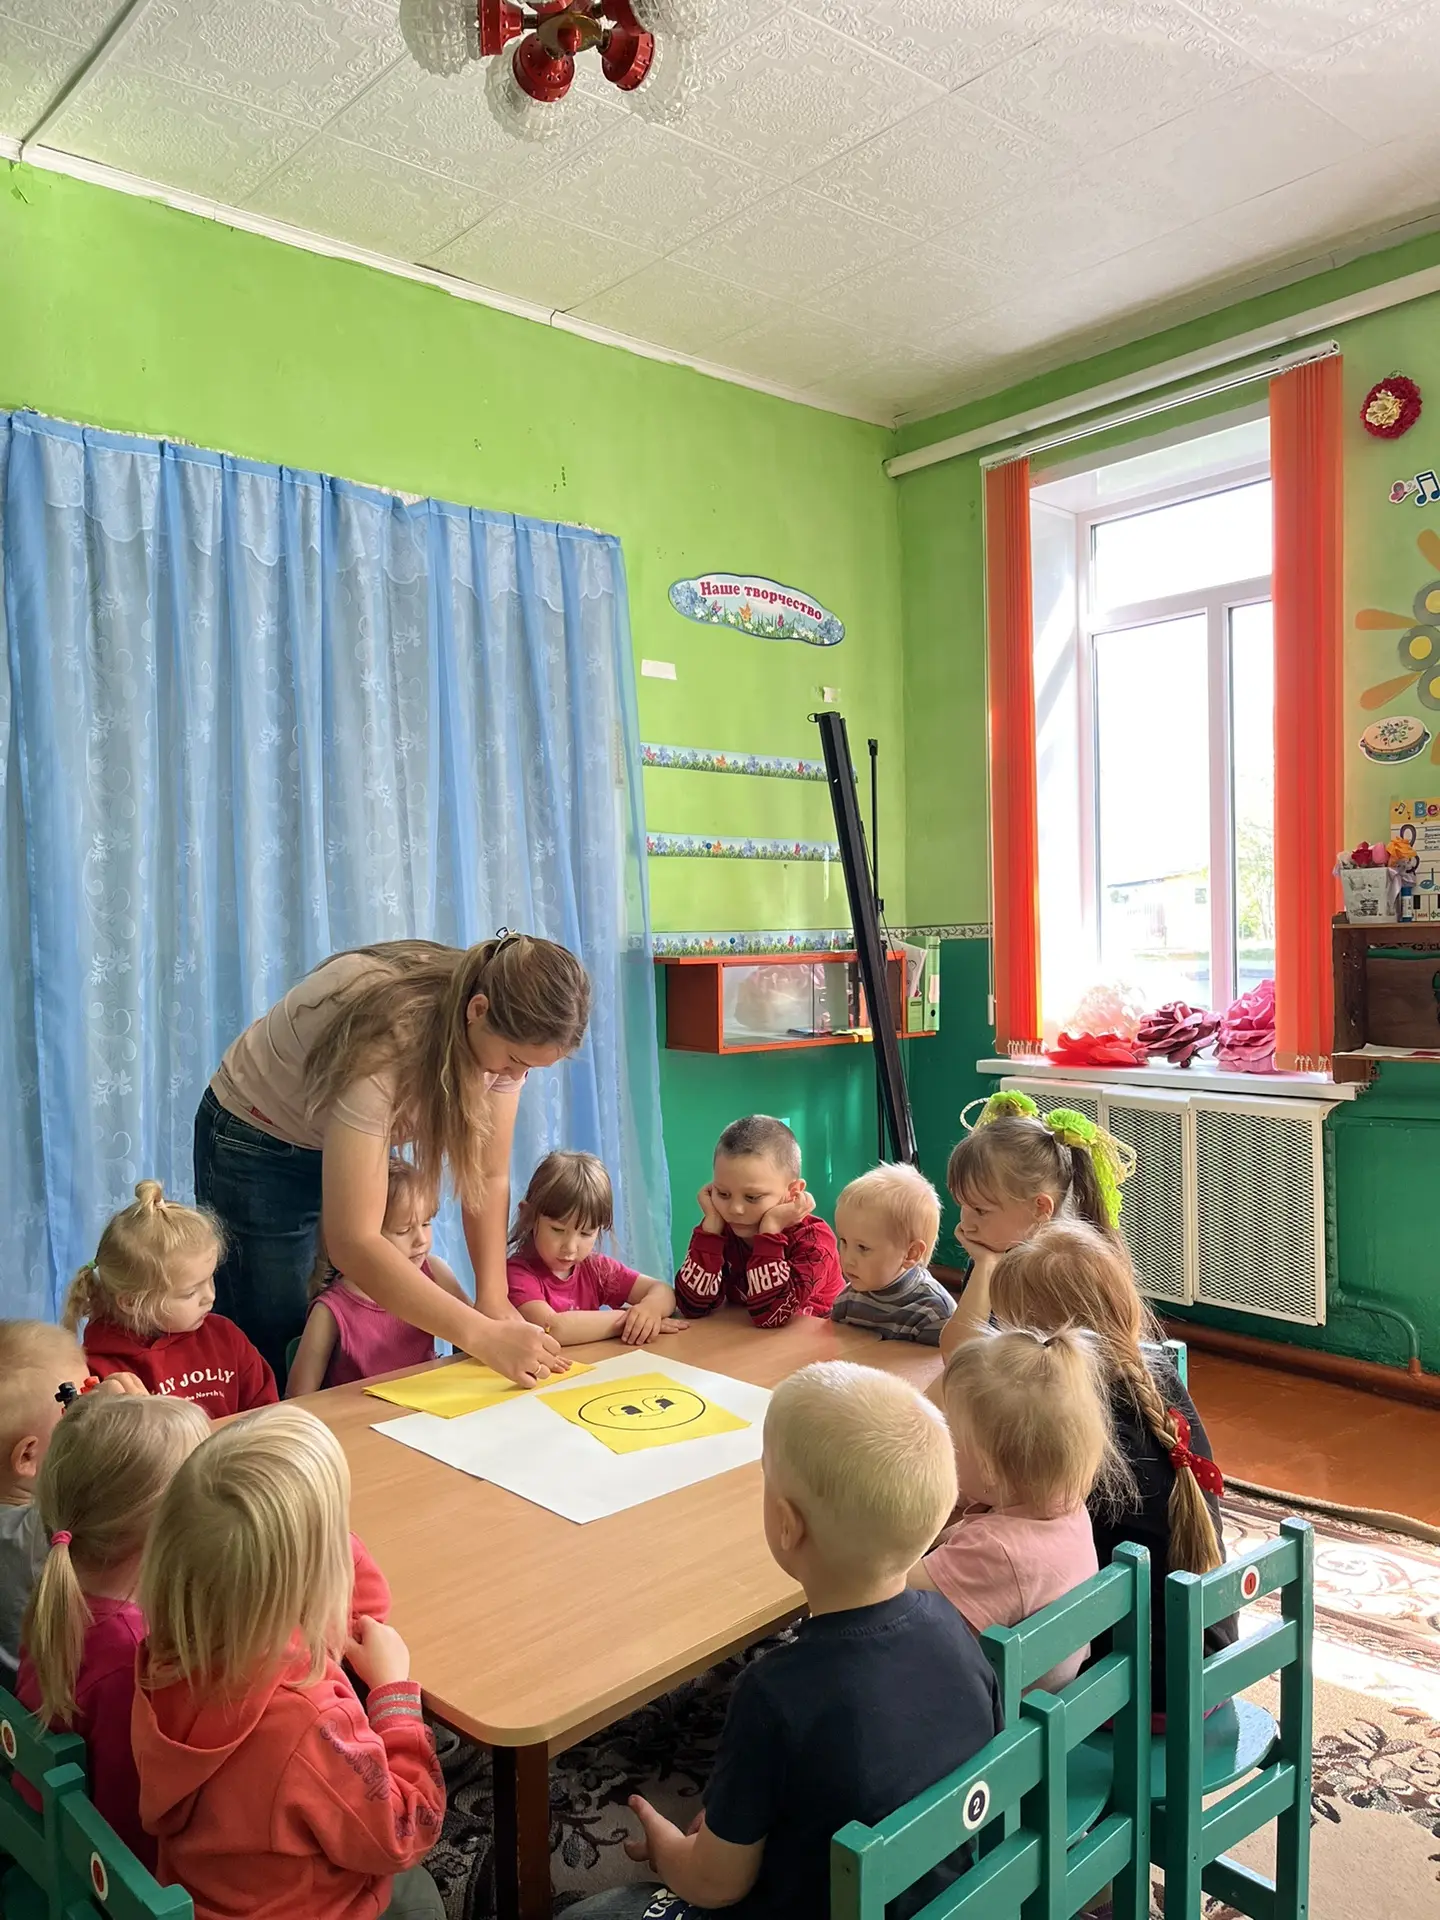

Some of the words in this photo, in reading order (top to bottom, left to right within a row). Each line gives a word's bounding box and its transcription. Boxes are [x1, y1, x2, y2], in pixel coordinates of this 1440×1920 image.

[699, 581, 741, 597] Наше
[743, 586, 823, 621] творчество
[1414, 801, 1440, 818] Ве
[179, 1367, 236, 1388] JOLLY
[971, 1796, 981, 1816] 2
